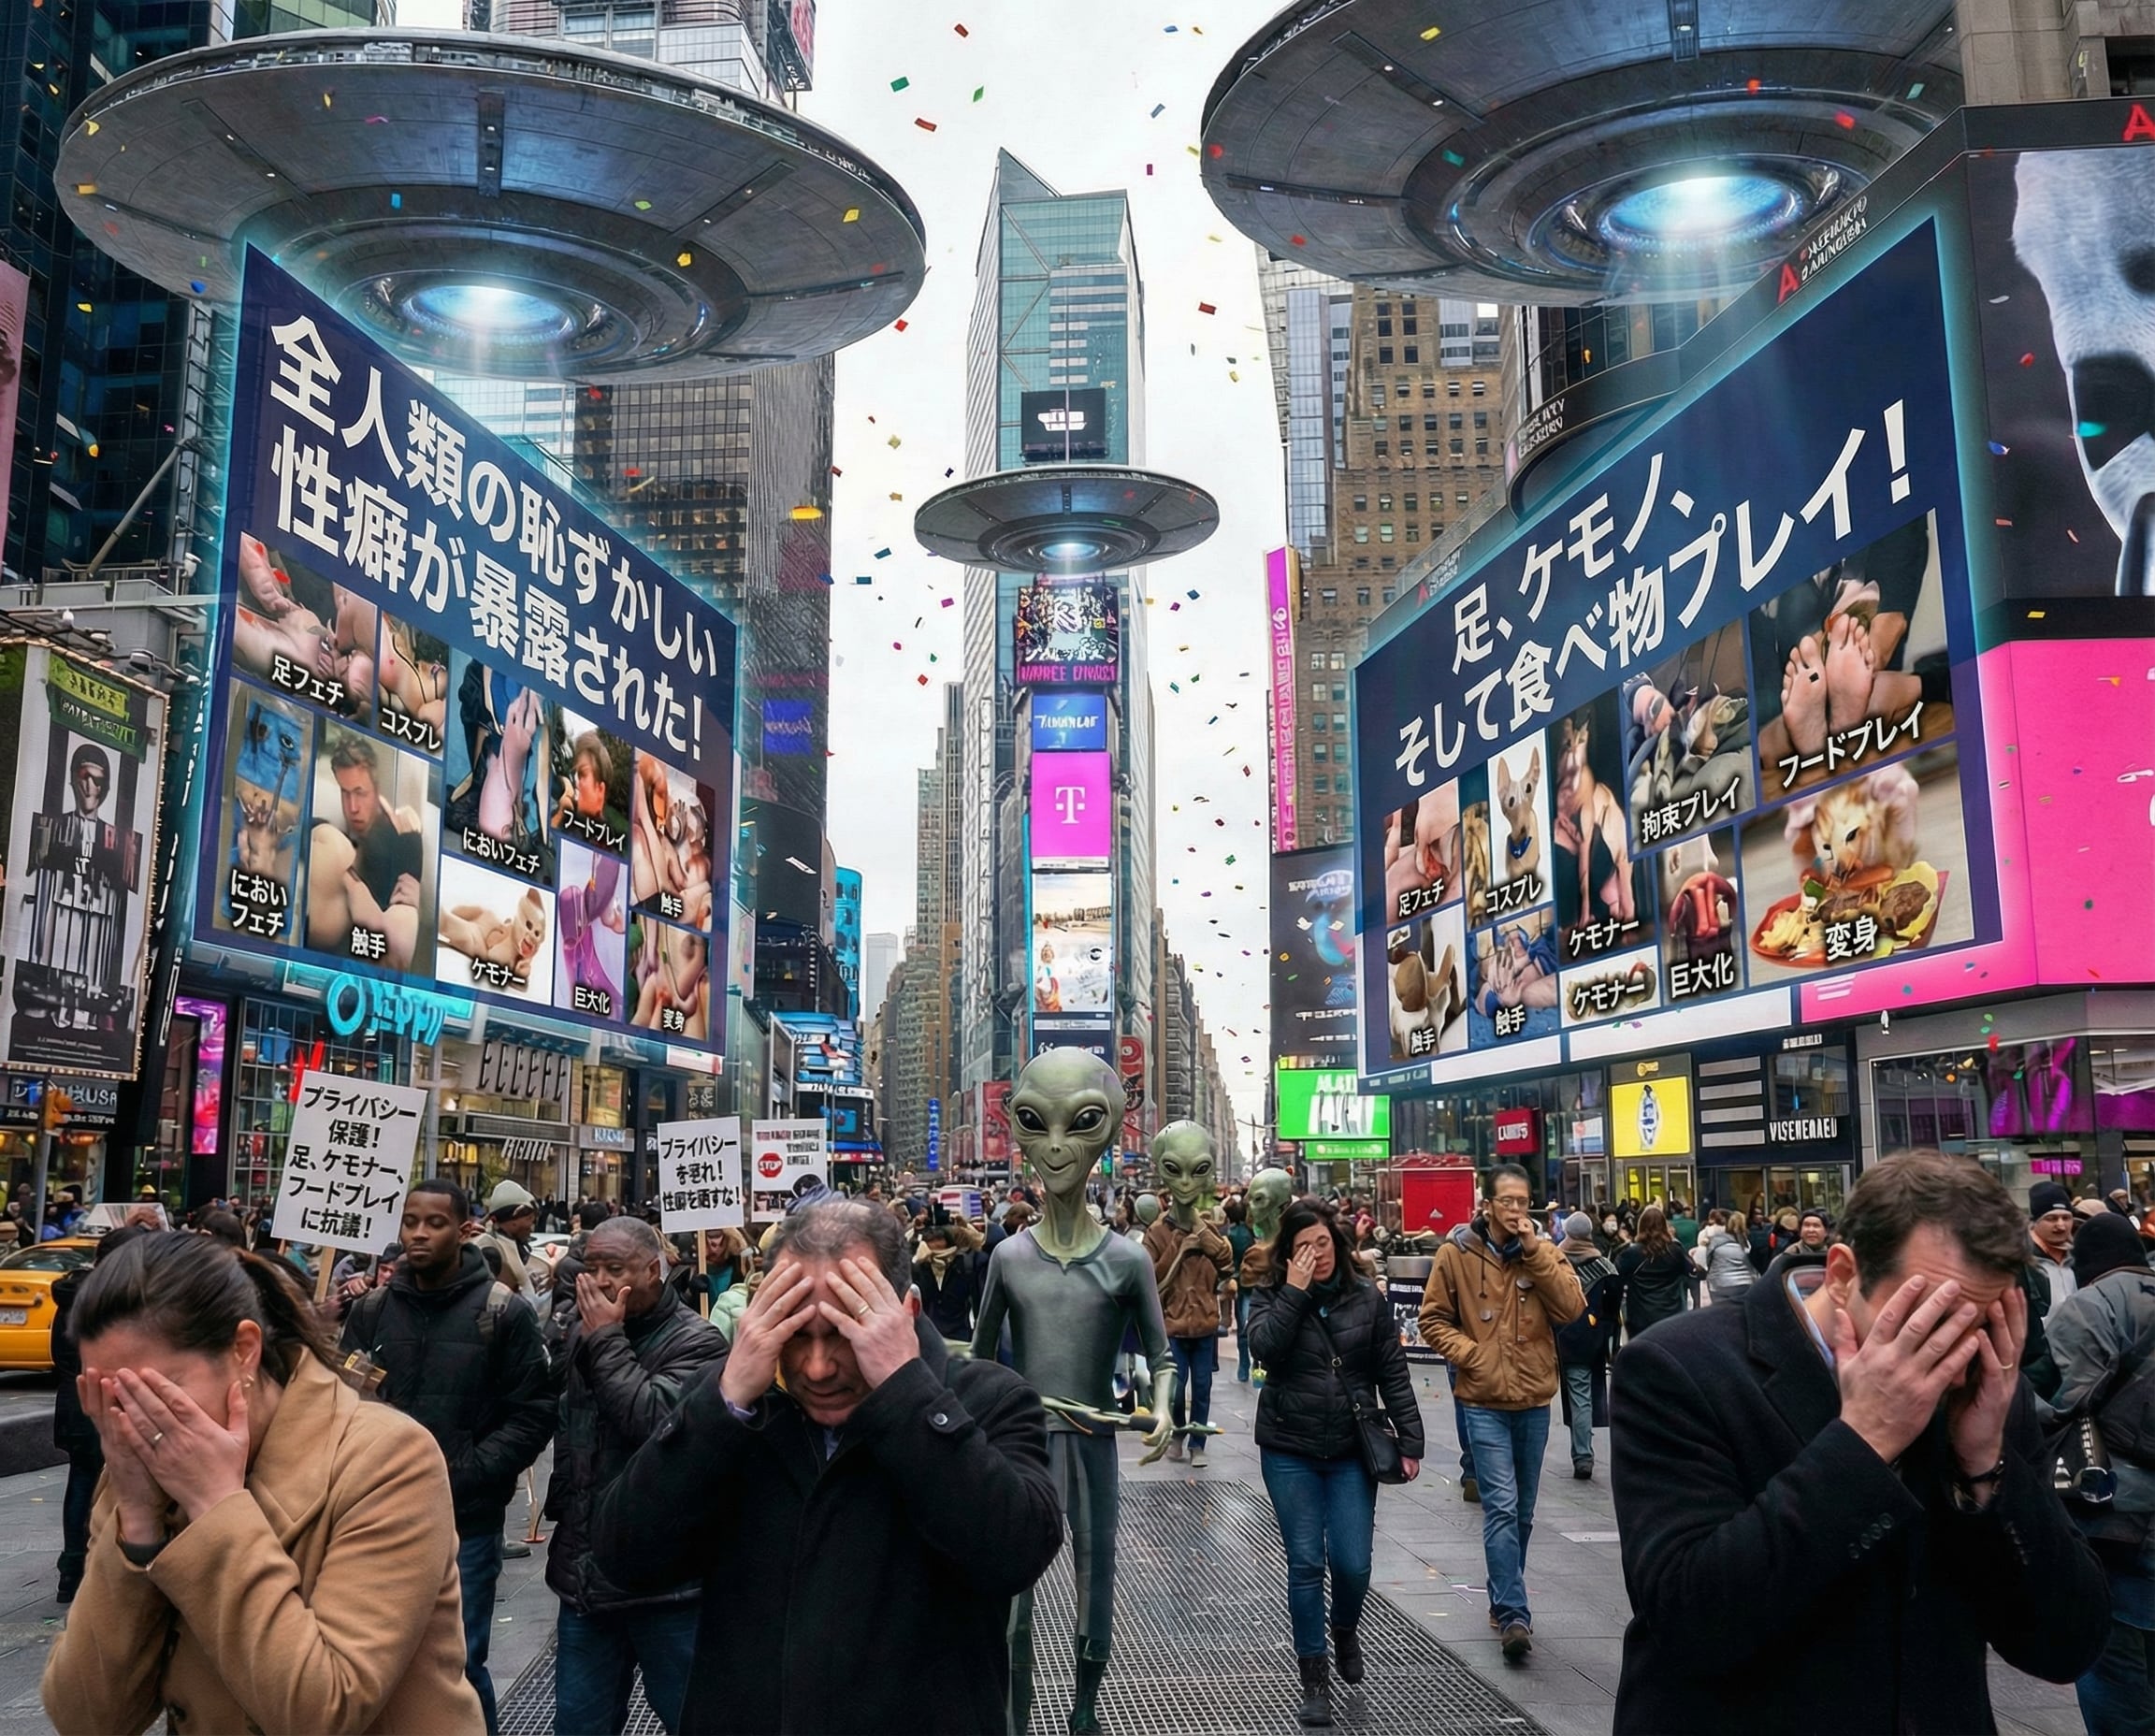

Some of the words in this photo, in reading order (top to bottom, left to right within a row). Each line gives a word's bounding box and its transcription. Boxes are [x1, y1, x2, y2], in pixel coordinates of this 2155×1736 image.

[270, 314, 717, 677] 全人類の恥ずかしい
[1452, 452, 1694, 675] 足、ケモノ、
[270, 427, 702, 761] 性癖が暴露された！
[1396, 398, 1911, 787] そして食べ物プレイ！
[271, 654, 344, 706] 足フェチ
[1778, 700, 1924, 788] フードプレイ
[1642, 776, 1741, 844] 拘束プレイ
[462, 826, 541, 875] においフェチ
[230, 868, 288, 906] におい
[1398, 877, 1445, 918] 足フェチ
[1485, 874, 1542, 914] コスプレ
[230, 902, 284, 936] フェチ
[1569, 918, 1640, 957] ケモナー
[1825, 914, 1878, 962] 変身
[470, 957, 527, 987] ケモナー
[1670, 952, 1735, 999] 巨大化
[574, 985, 611, 1015] 巨大化
[1573, 979, 1645, 1017] ケモナー
[304, 1085, 417, 1121] プライバシー
[289, 1144, 405, 1184] 足、ケモナー、
[288, 1175, 401, 1214] フードプレイ
